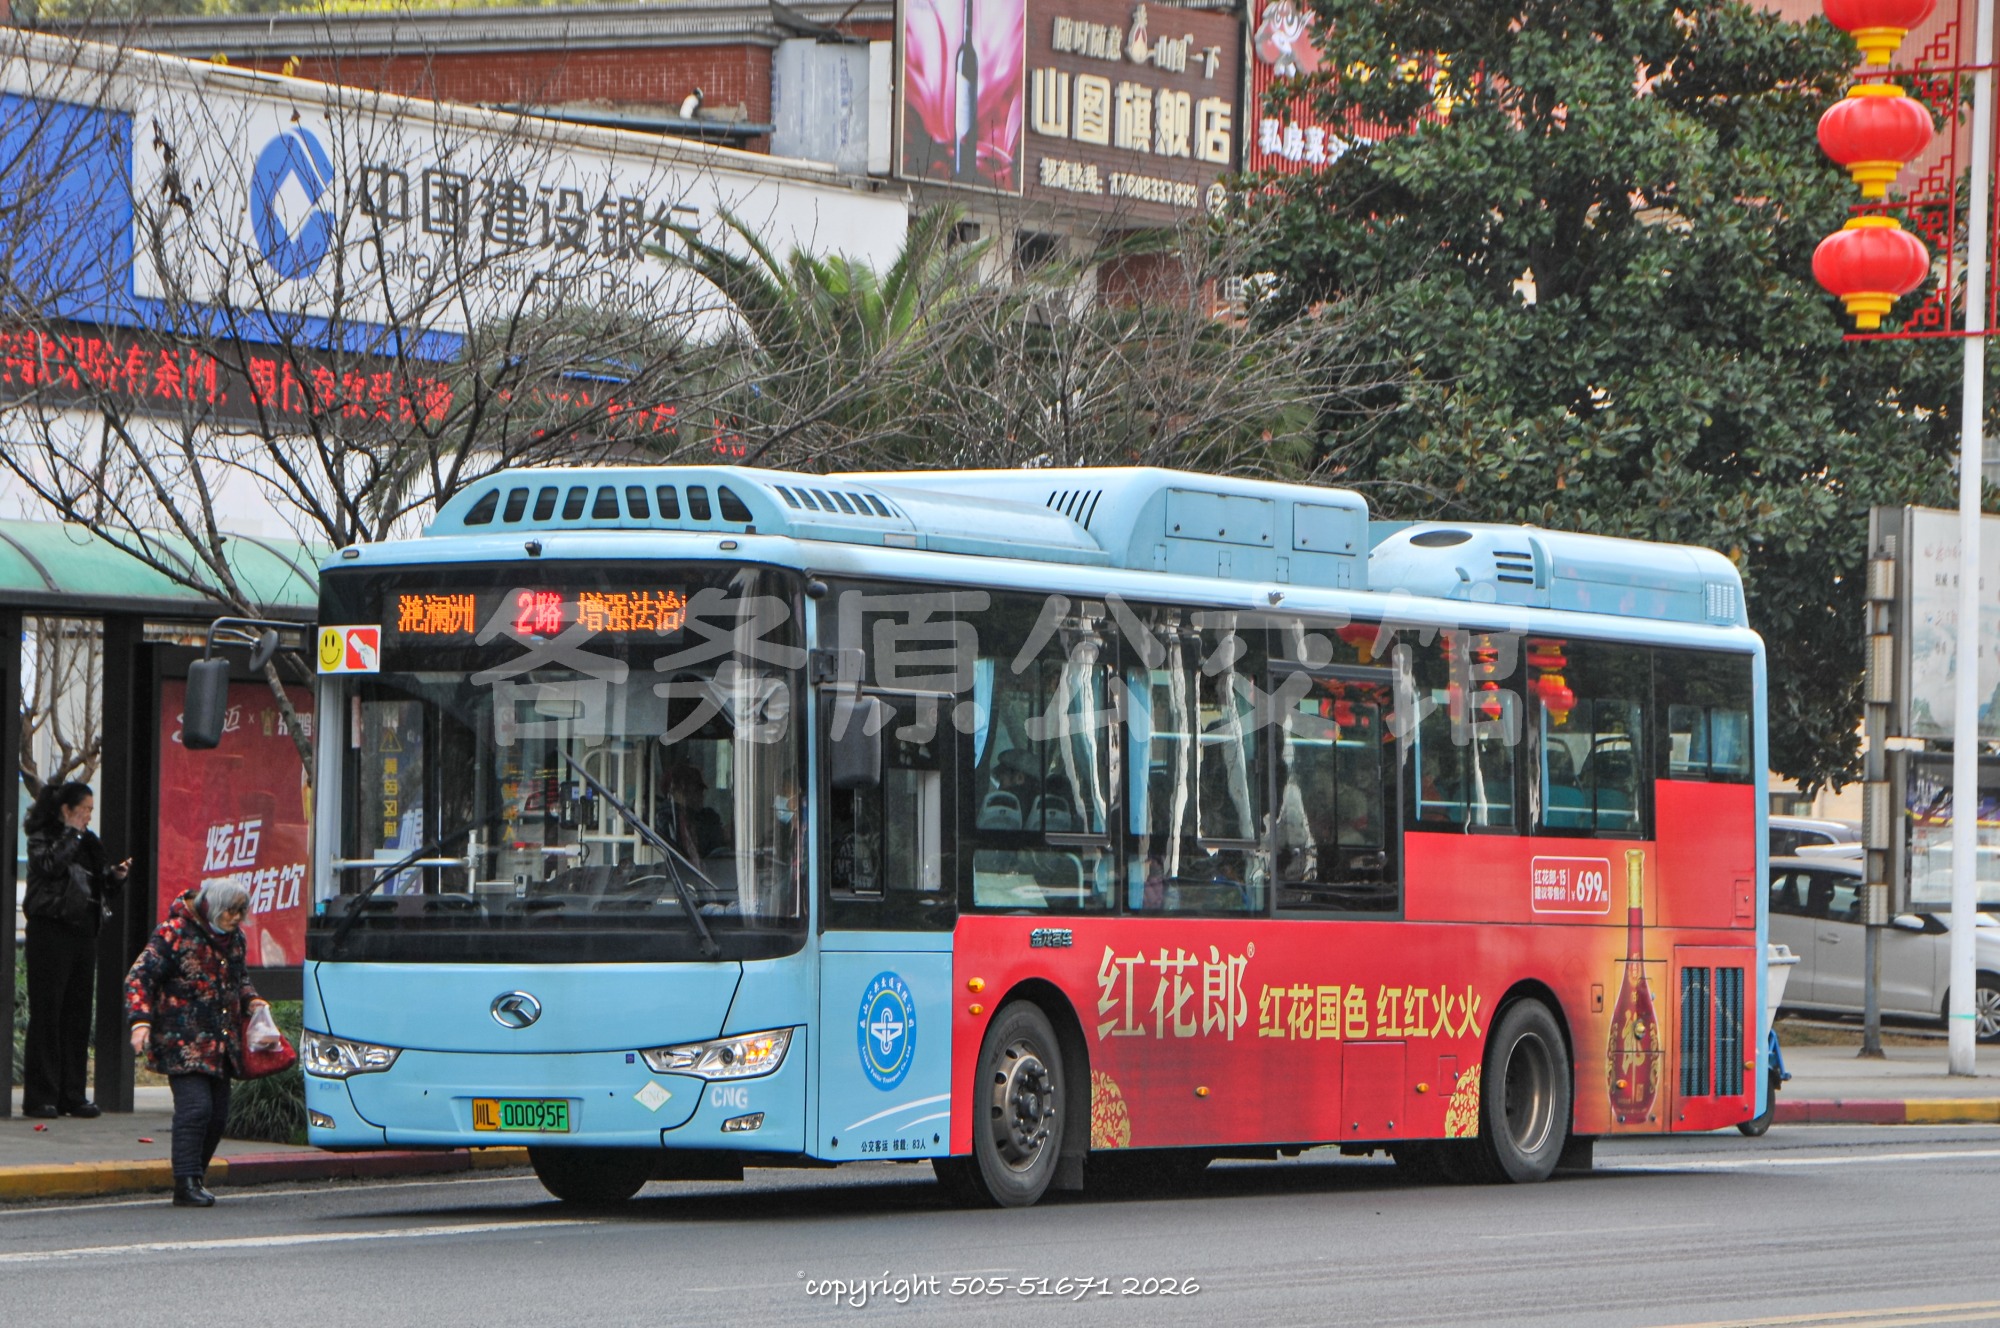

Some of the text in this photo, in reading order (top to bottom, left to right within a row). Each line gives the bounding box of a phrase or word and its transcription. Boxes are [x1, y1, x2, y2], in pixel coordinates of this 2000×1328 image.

[1031, 67, 1231, 164] 山图旗舰店
[1259, 118, 1372, 165] 私房菜
[360, 162, 700, 264] 中国建设银行
[517, 592, 562, 633] 2路
[577, 590, 687, 631] 增强法治
[202, 819, 262, 872] 炫迈
[199, 863, 306, 914] 特饮
[1258, 983, 1482, 1040] 红花国色 红红火火
[475, 1103, 566, 1127] 川L 00095F
[711, 1087, 748, 1108] CNG
[861, 1140, 889, 1152] 公交客运
